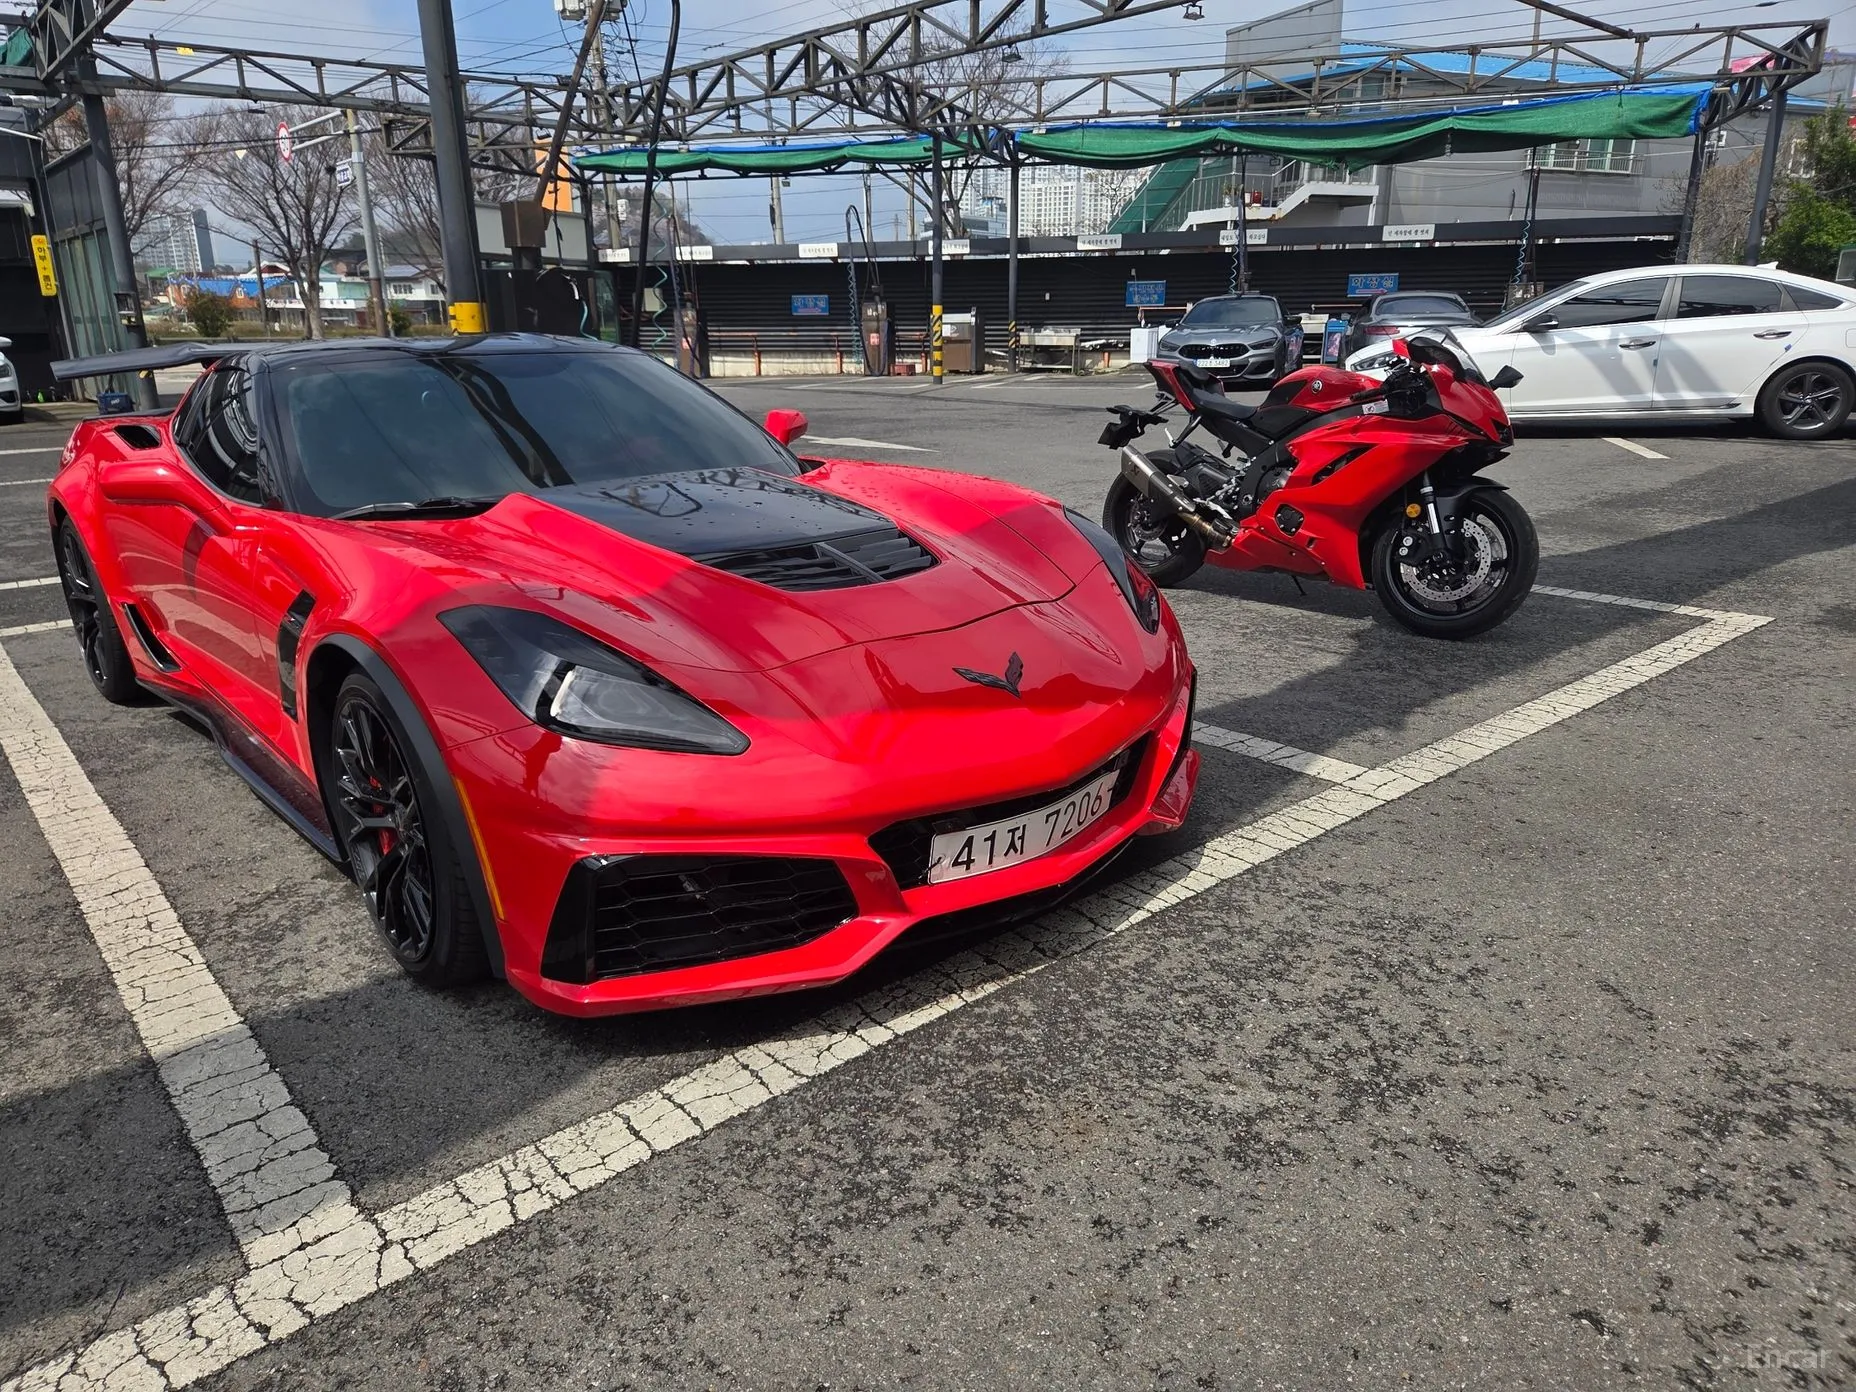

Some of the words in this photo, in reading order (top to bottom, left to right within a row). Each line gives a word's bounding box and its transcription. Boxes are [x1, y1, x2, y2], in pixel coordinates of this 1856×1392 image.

[1351, 276, 1395, 289] 화장실
[951, 823, 1026, 872] 41저
[1044, 781, 1104, 848] 7206
